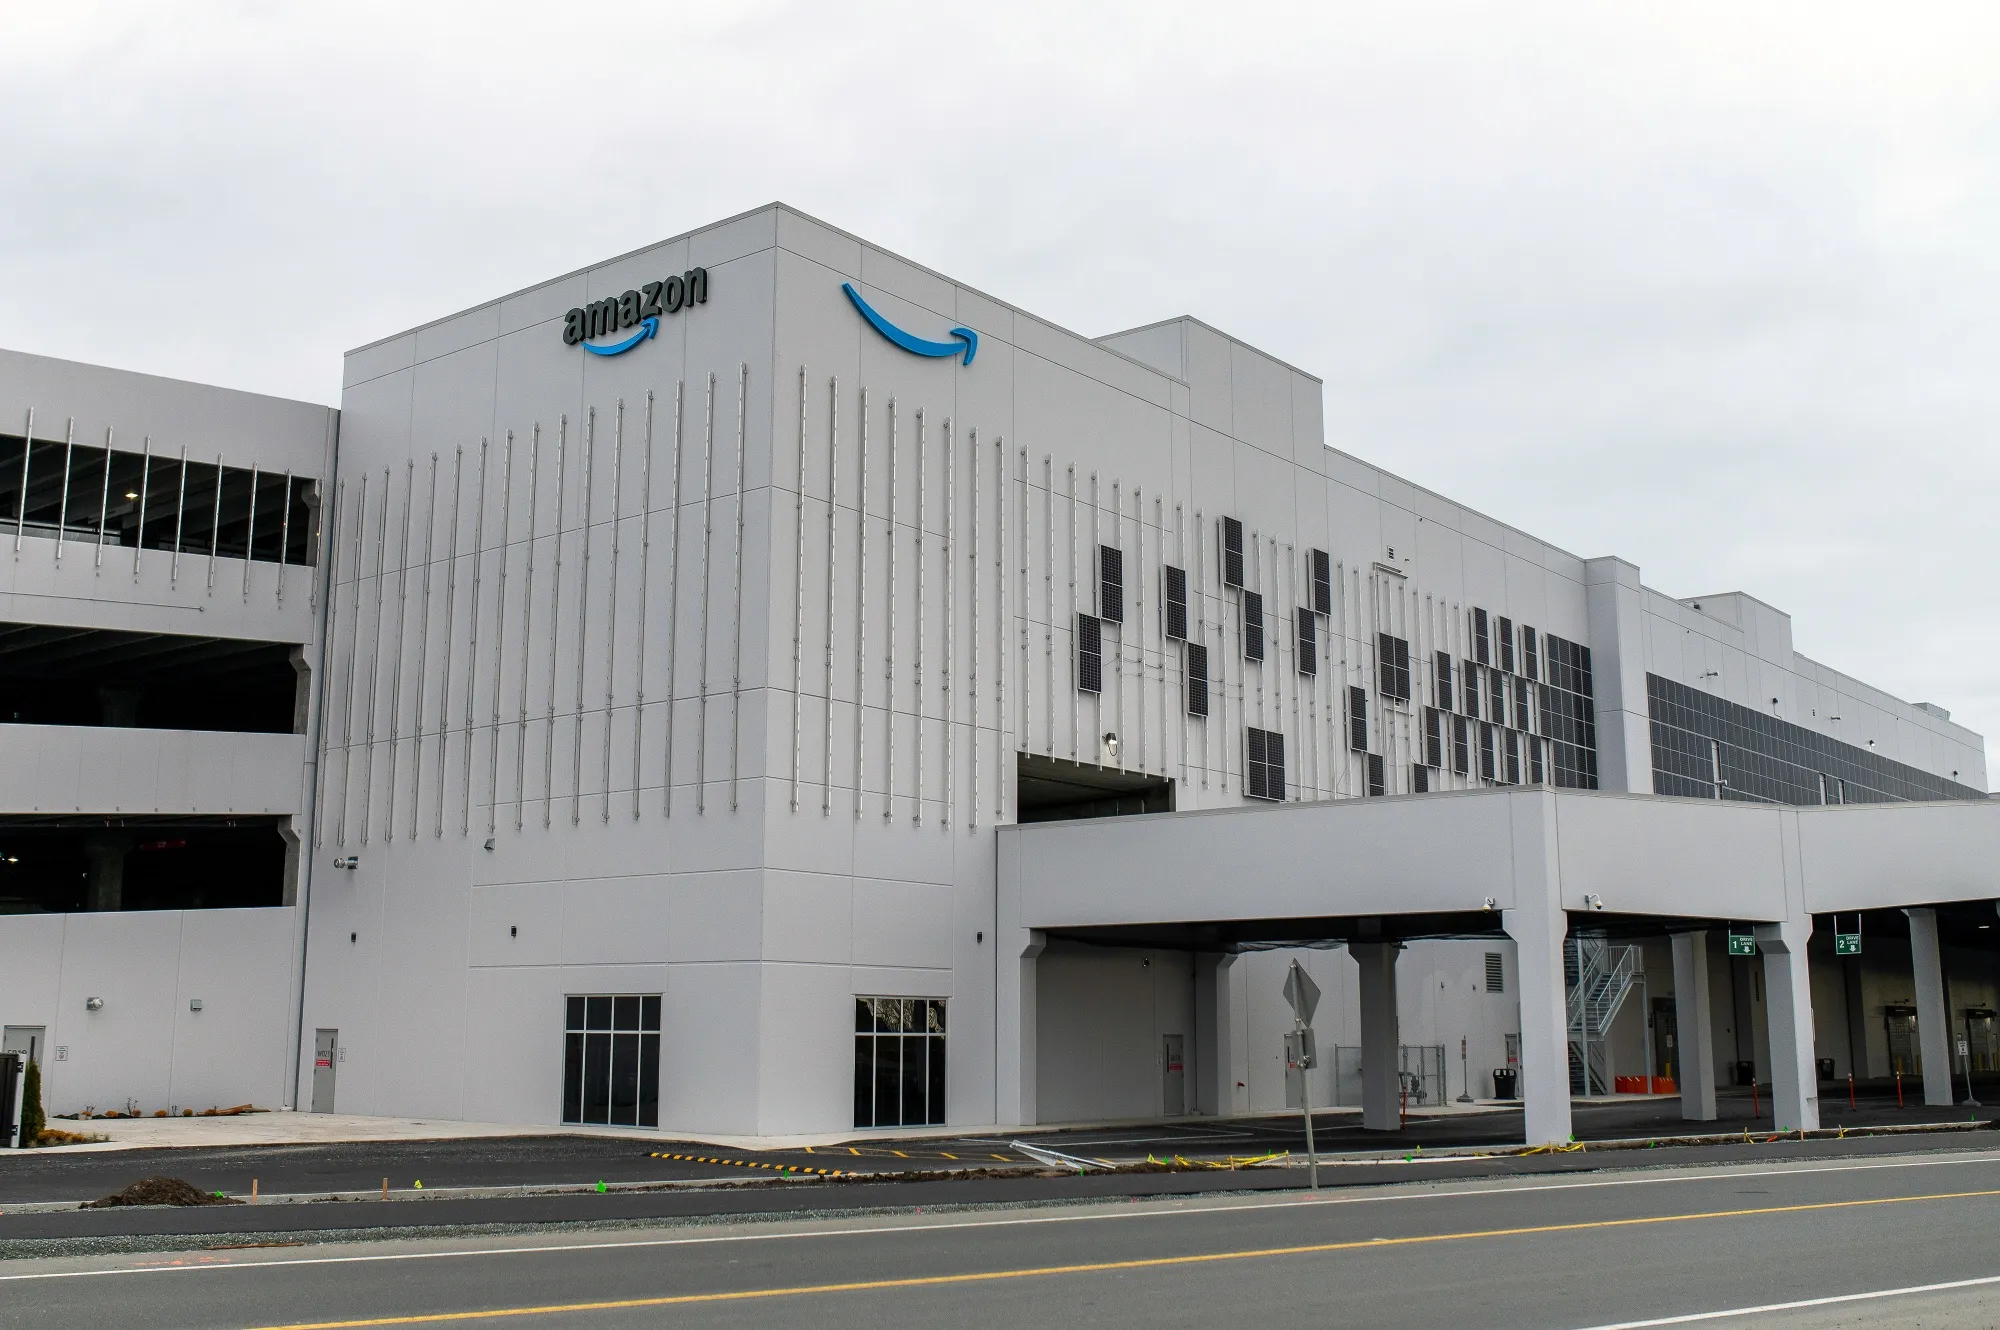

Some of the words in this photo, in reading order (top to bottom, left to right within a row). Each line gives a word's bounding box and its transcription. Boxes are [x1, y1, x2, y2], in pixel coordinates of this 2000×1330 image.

[562, 266, 707, 345] amazon
[1733, 941, 1737, 949] 1
[1840, 940, 1845, 949] 2
